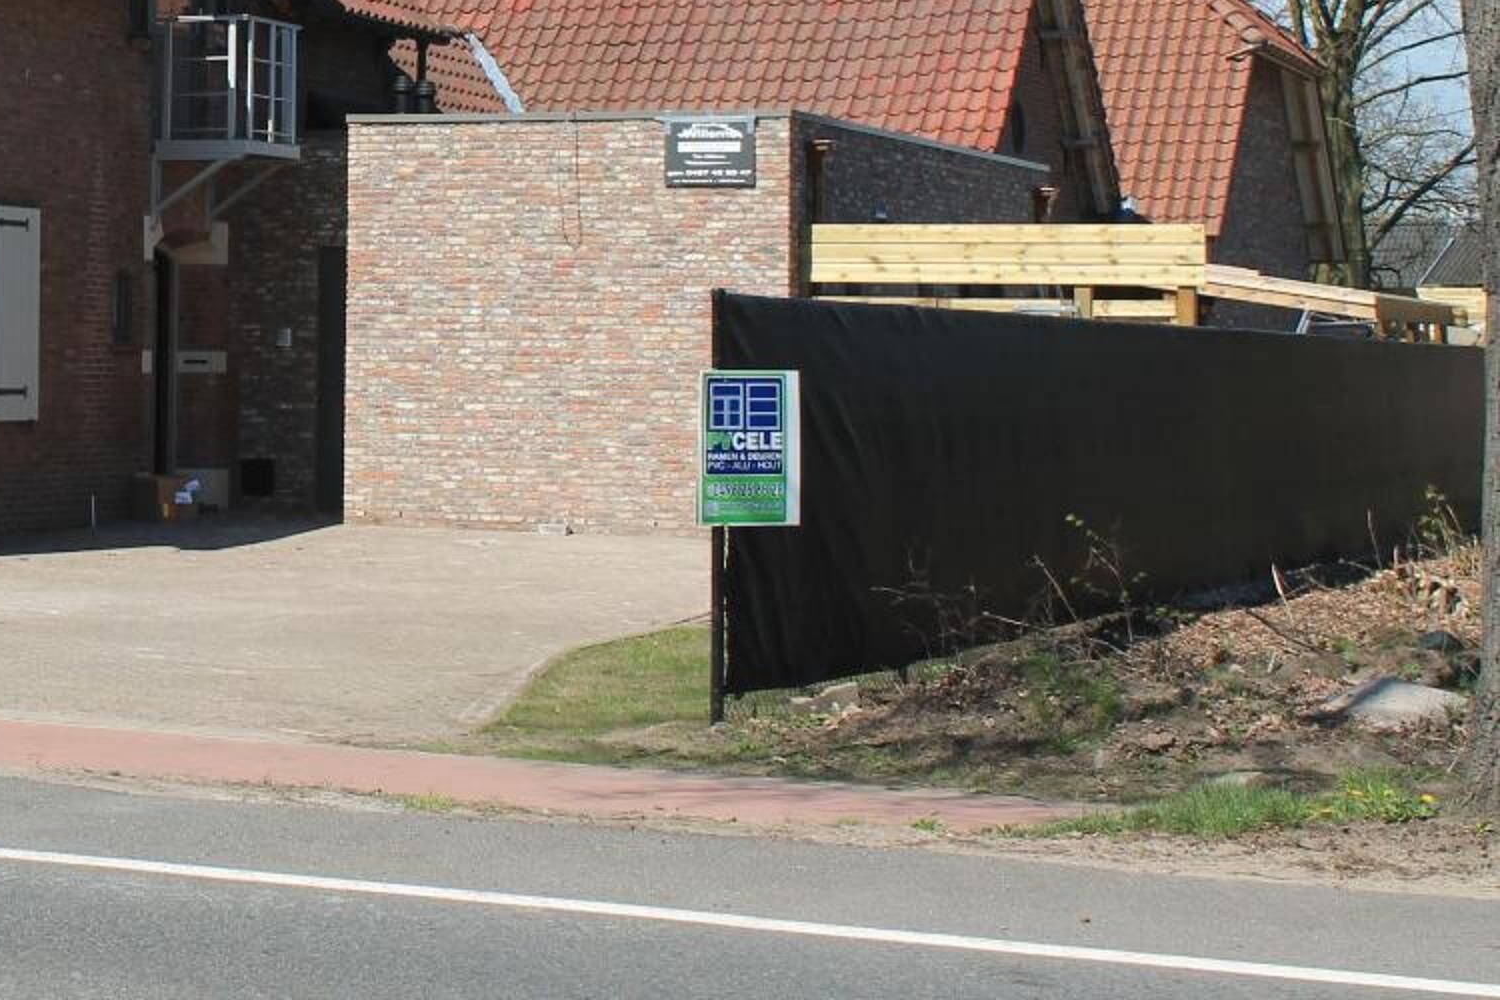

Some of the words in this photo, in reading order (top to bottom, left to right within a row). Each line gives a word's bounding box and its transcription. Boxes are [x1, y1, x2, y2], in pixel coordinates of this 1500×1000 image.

[707, 452, 738, 460] RAMEN
[740, 452, 746, 460] &
[748, 452, 781, 460] DEUREN
[707, 461, 725, 470] PVC
[733, 461, 750, 470] ALU
[757, 461, 781, 469] HOUT
